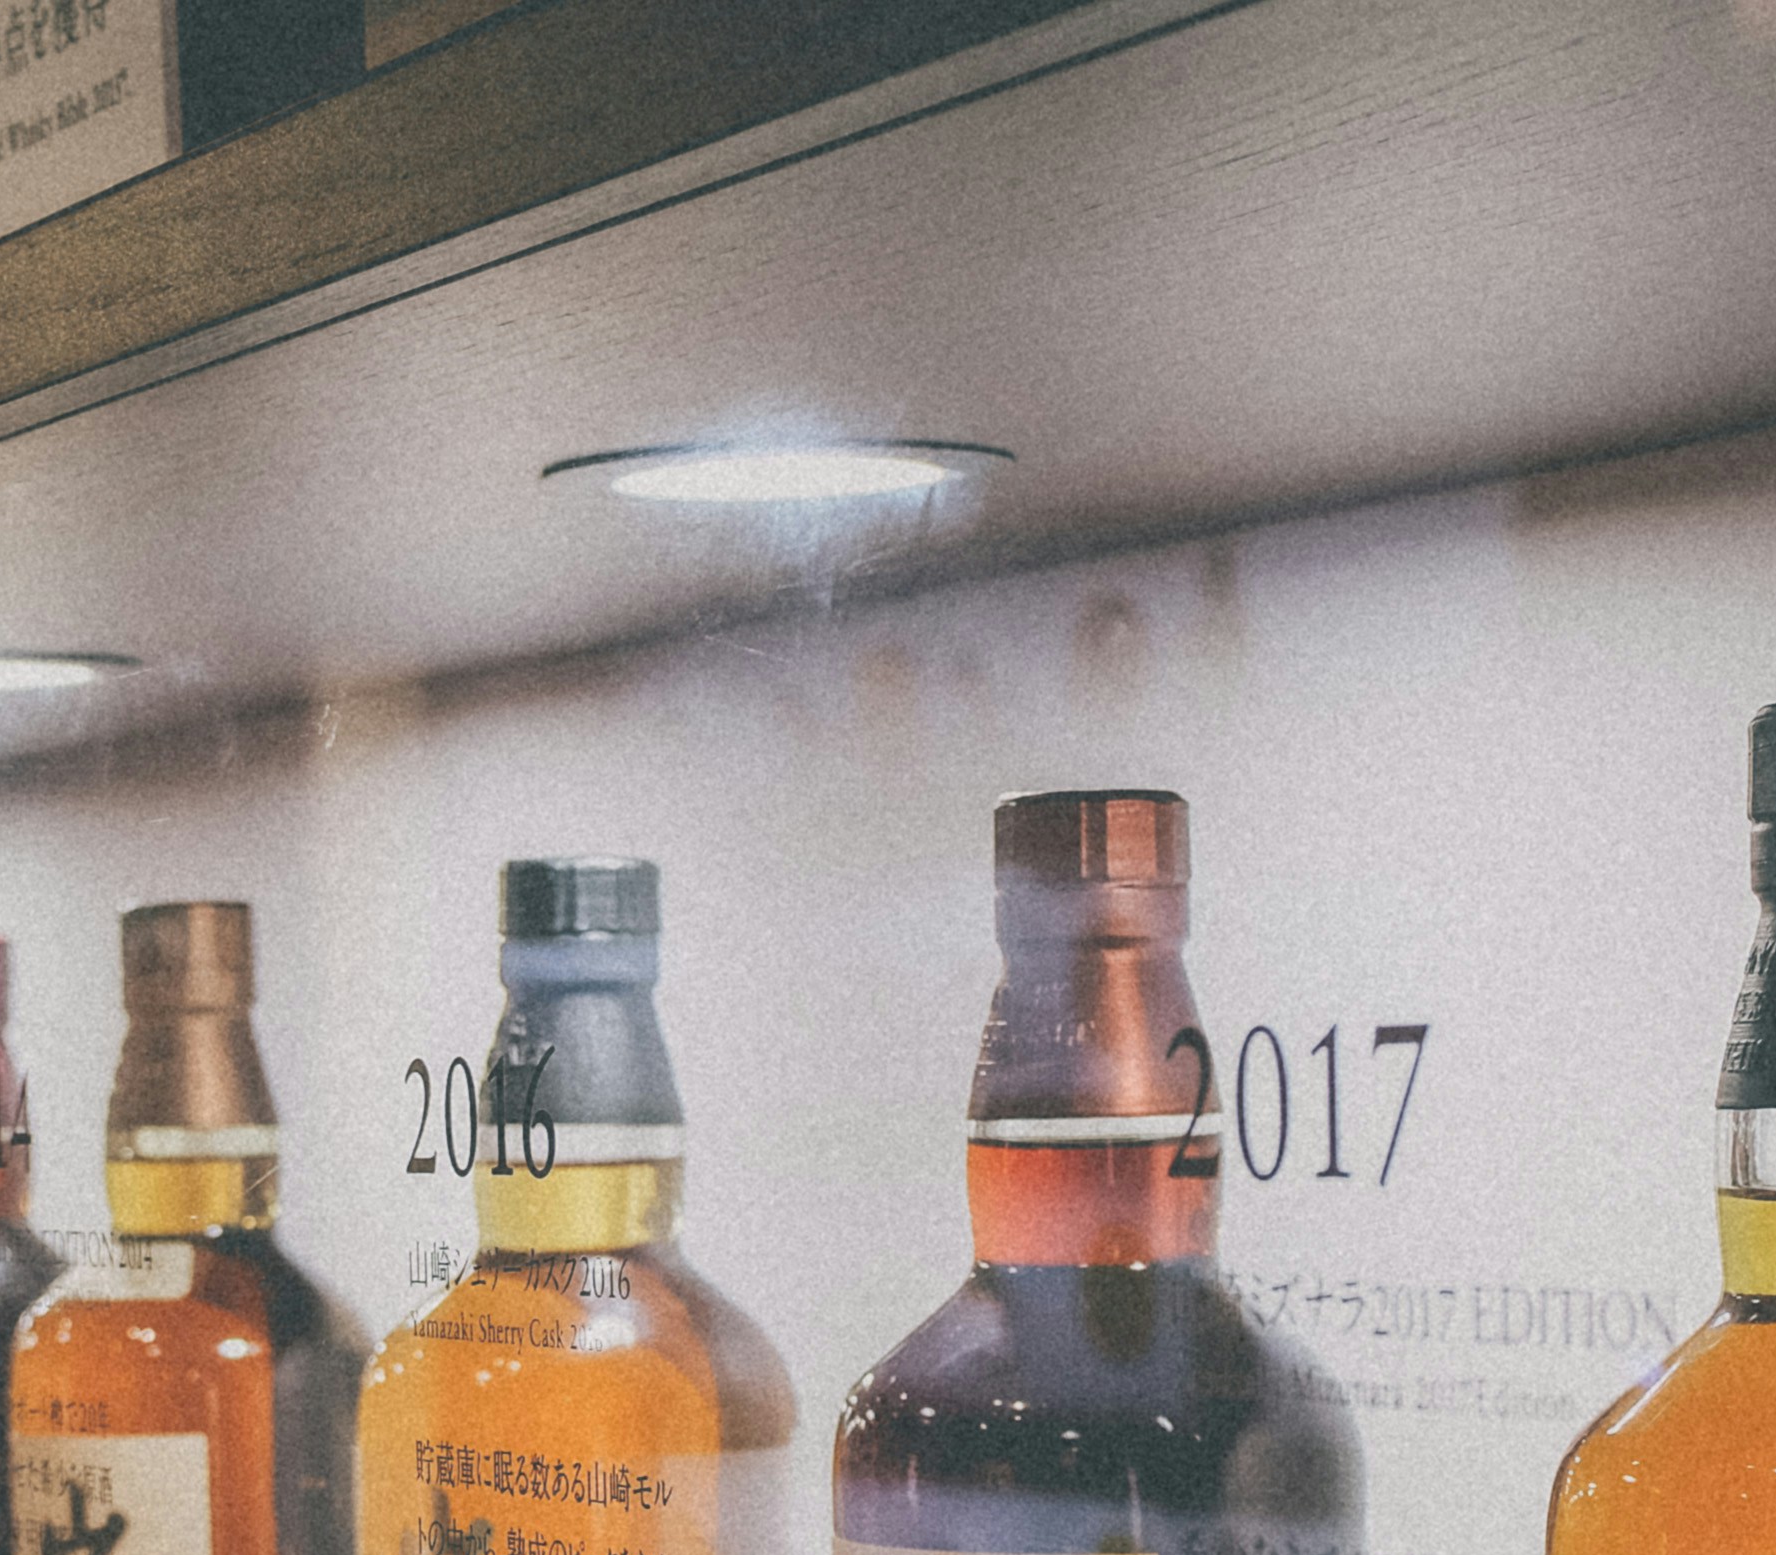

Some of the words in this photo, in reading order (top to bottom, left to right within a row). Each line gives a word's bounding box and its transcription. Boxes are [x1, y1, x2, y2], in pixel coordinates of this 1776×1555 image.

[405, 1046, 555, 1179] 2016
[1165, 1022, 1429, 1186] 2017
[408, 1241, 630, 1300] 山崎シェリーカスク2016
[411, 1311, 474, 1343] Yamazaki
[479, 1315, 524, 1354] Sherry
[529, 1318, 563, 1349] Cask
[415, 1439, 673, 1511] 貯蔵庫に眠る数ある山崎モル
